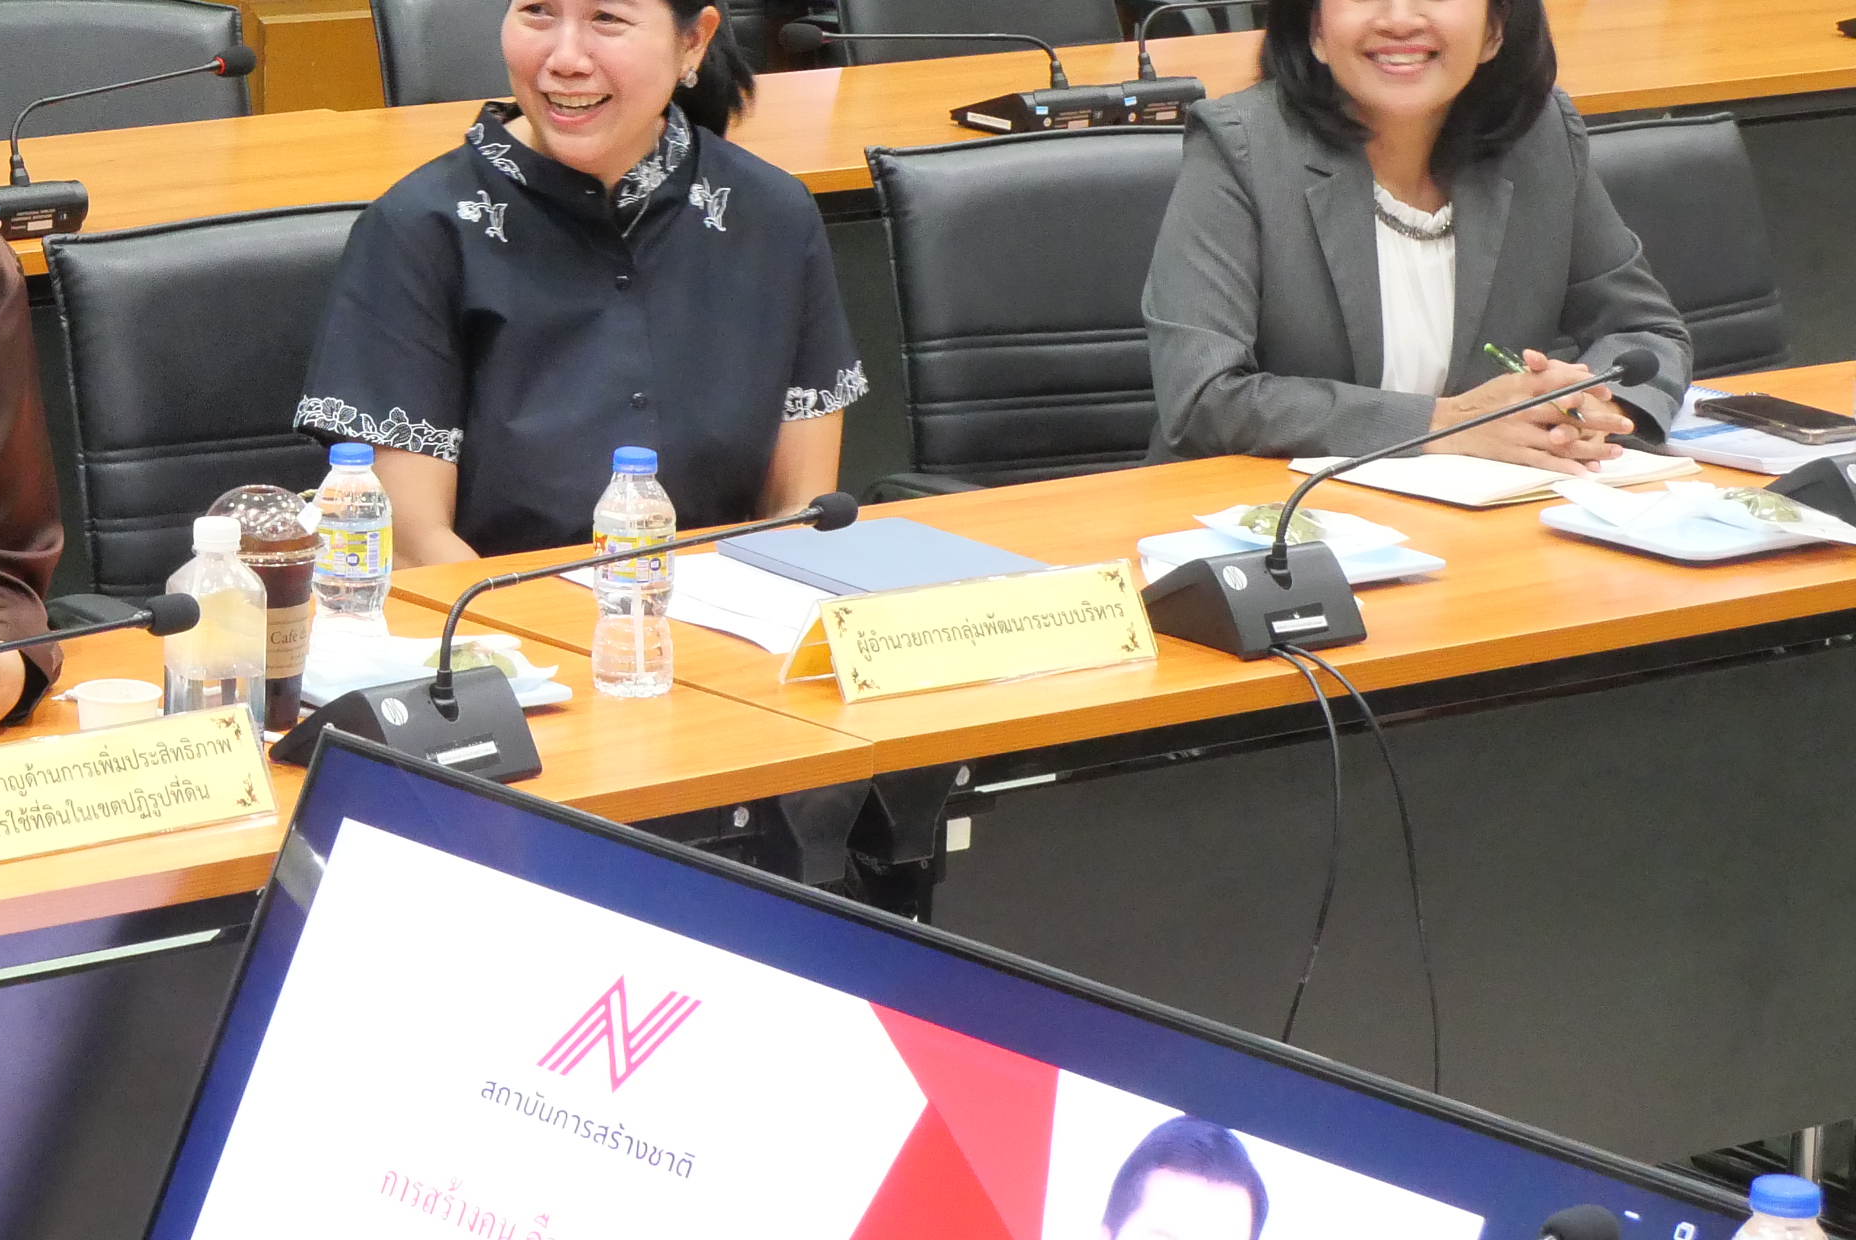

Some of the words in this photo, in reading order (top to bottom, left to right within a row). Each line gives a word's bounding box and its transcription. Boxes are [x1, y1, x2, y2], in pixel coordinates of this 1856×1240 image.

[856, 600, 1125, 662] ผู้อำนวยการกลุ่มพัฒนาระบบบริหาร
[480, 1079, 696, 1179] สถาบันการสร้างชาติ
